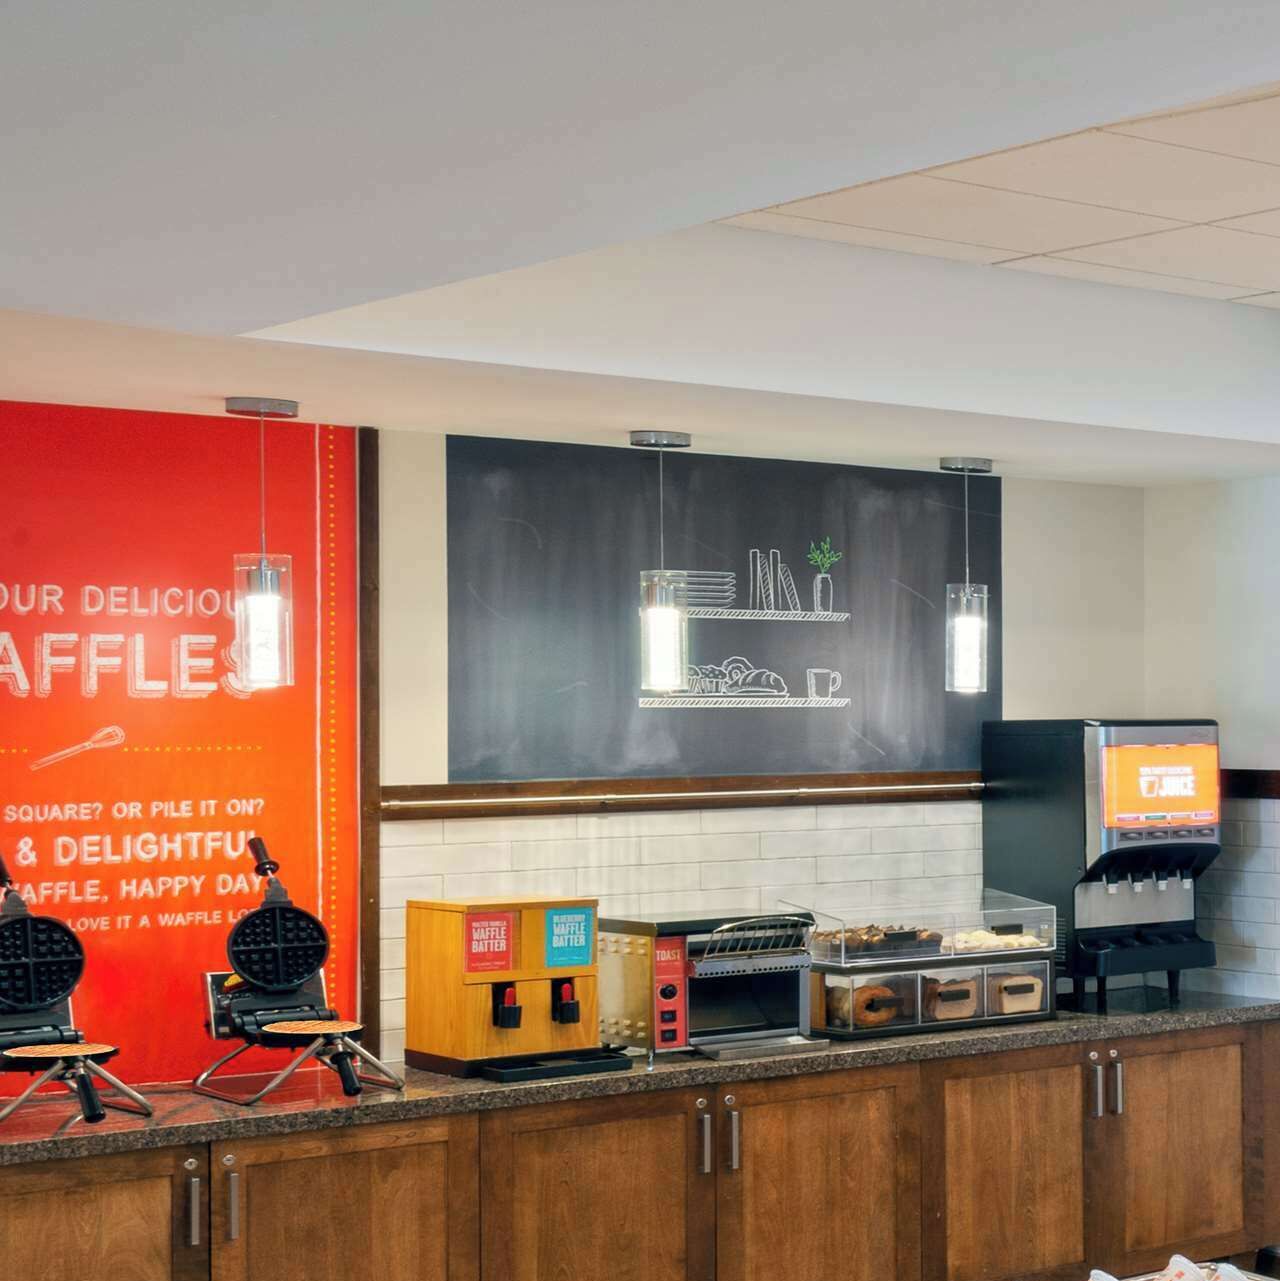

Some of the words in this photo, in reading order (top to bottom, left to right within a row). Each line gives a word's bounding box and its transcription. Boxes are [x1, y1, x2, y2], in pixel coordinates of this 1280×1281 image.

[4, 802, 103, 823] SQUARE?
[112, 801, 142, 820] OR
[151, 800, 193, 818] PILE
[200, 799, 218, 816] IT
[225, 798, 265, 816] ON?
[16, 836, 37, 867] &
[119, 874, 206, 900] HAPPY
[67, 916, 110, 932] LOVE
[116, 915, 133, 930] IT
[139, 914, 151, 928] A
[157, 910, 222, 927] WAFFLE
[228, 907, 259, 923] LO
[472, 926, 507, 940] WAFFLE
[553, 922, 586, 936] WAFFLE
[471, 939, 507, 953] BATTER
[552, 935, 586, 948] BATTER
[655, 950, 681, 961] TOAST
